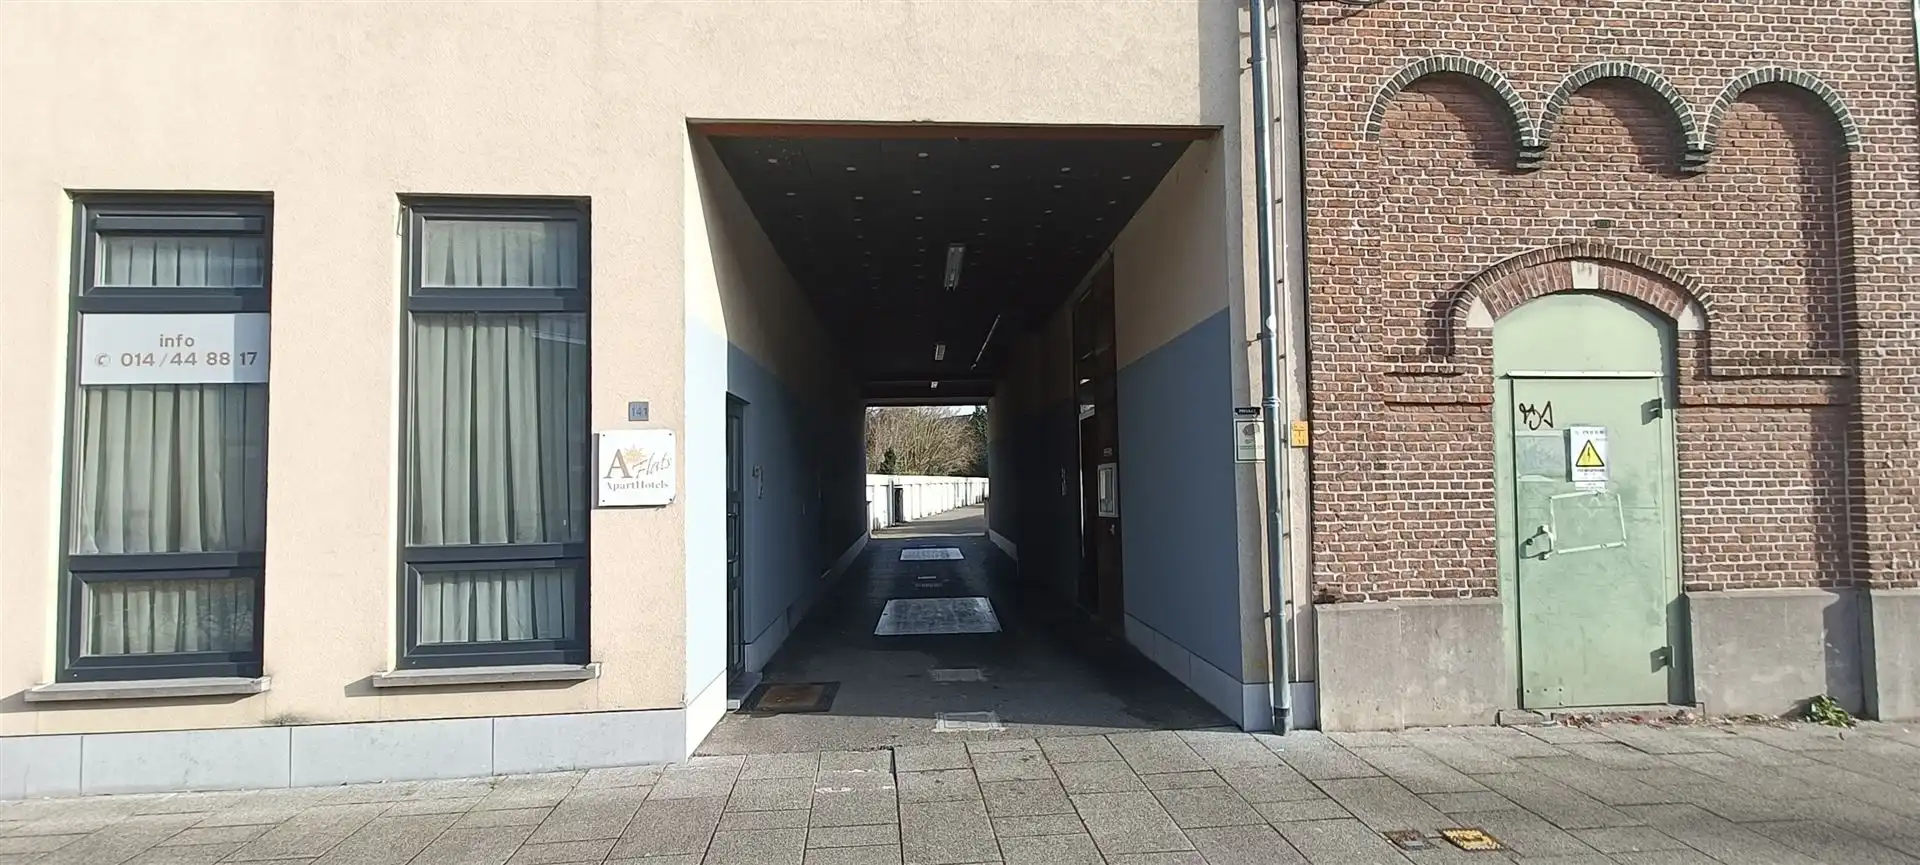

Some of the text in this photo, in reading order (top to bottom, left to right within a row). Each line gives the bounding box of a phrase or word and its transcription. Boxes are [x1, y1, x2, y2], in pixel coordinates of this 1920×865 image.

[159, 334, 195, 348] info
[206, 352, 231, 366] 88
[239, 352, 258, 366] 17
[632, 407, 648, 417] 141
[603, 449, 672, 479] A Flats
[607, 480, 669, 491] ApartHotels
